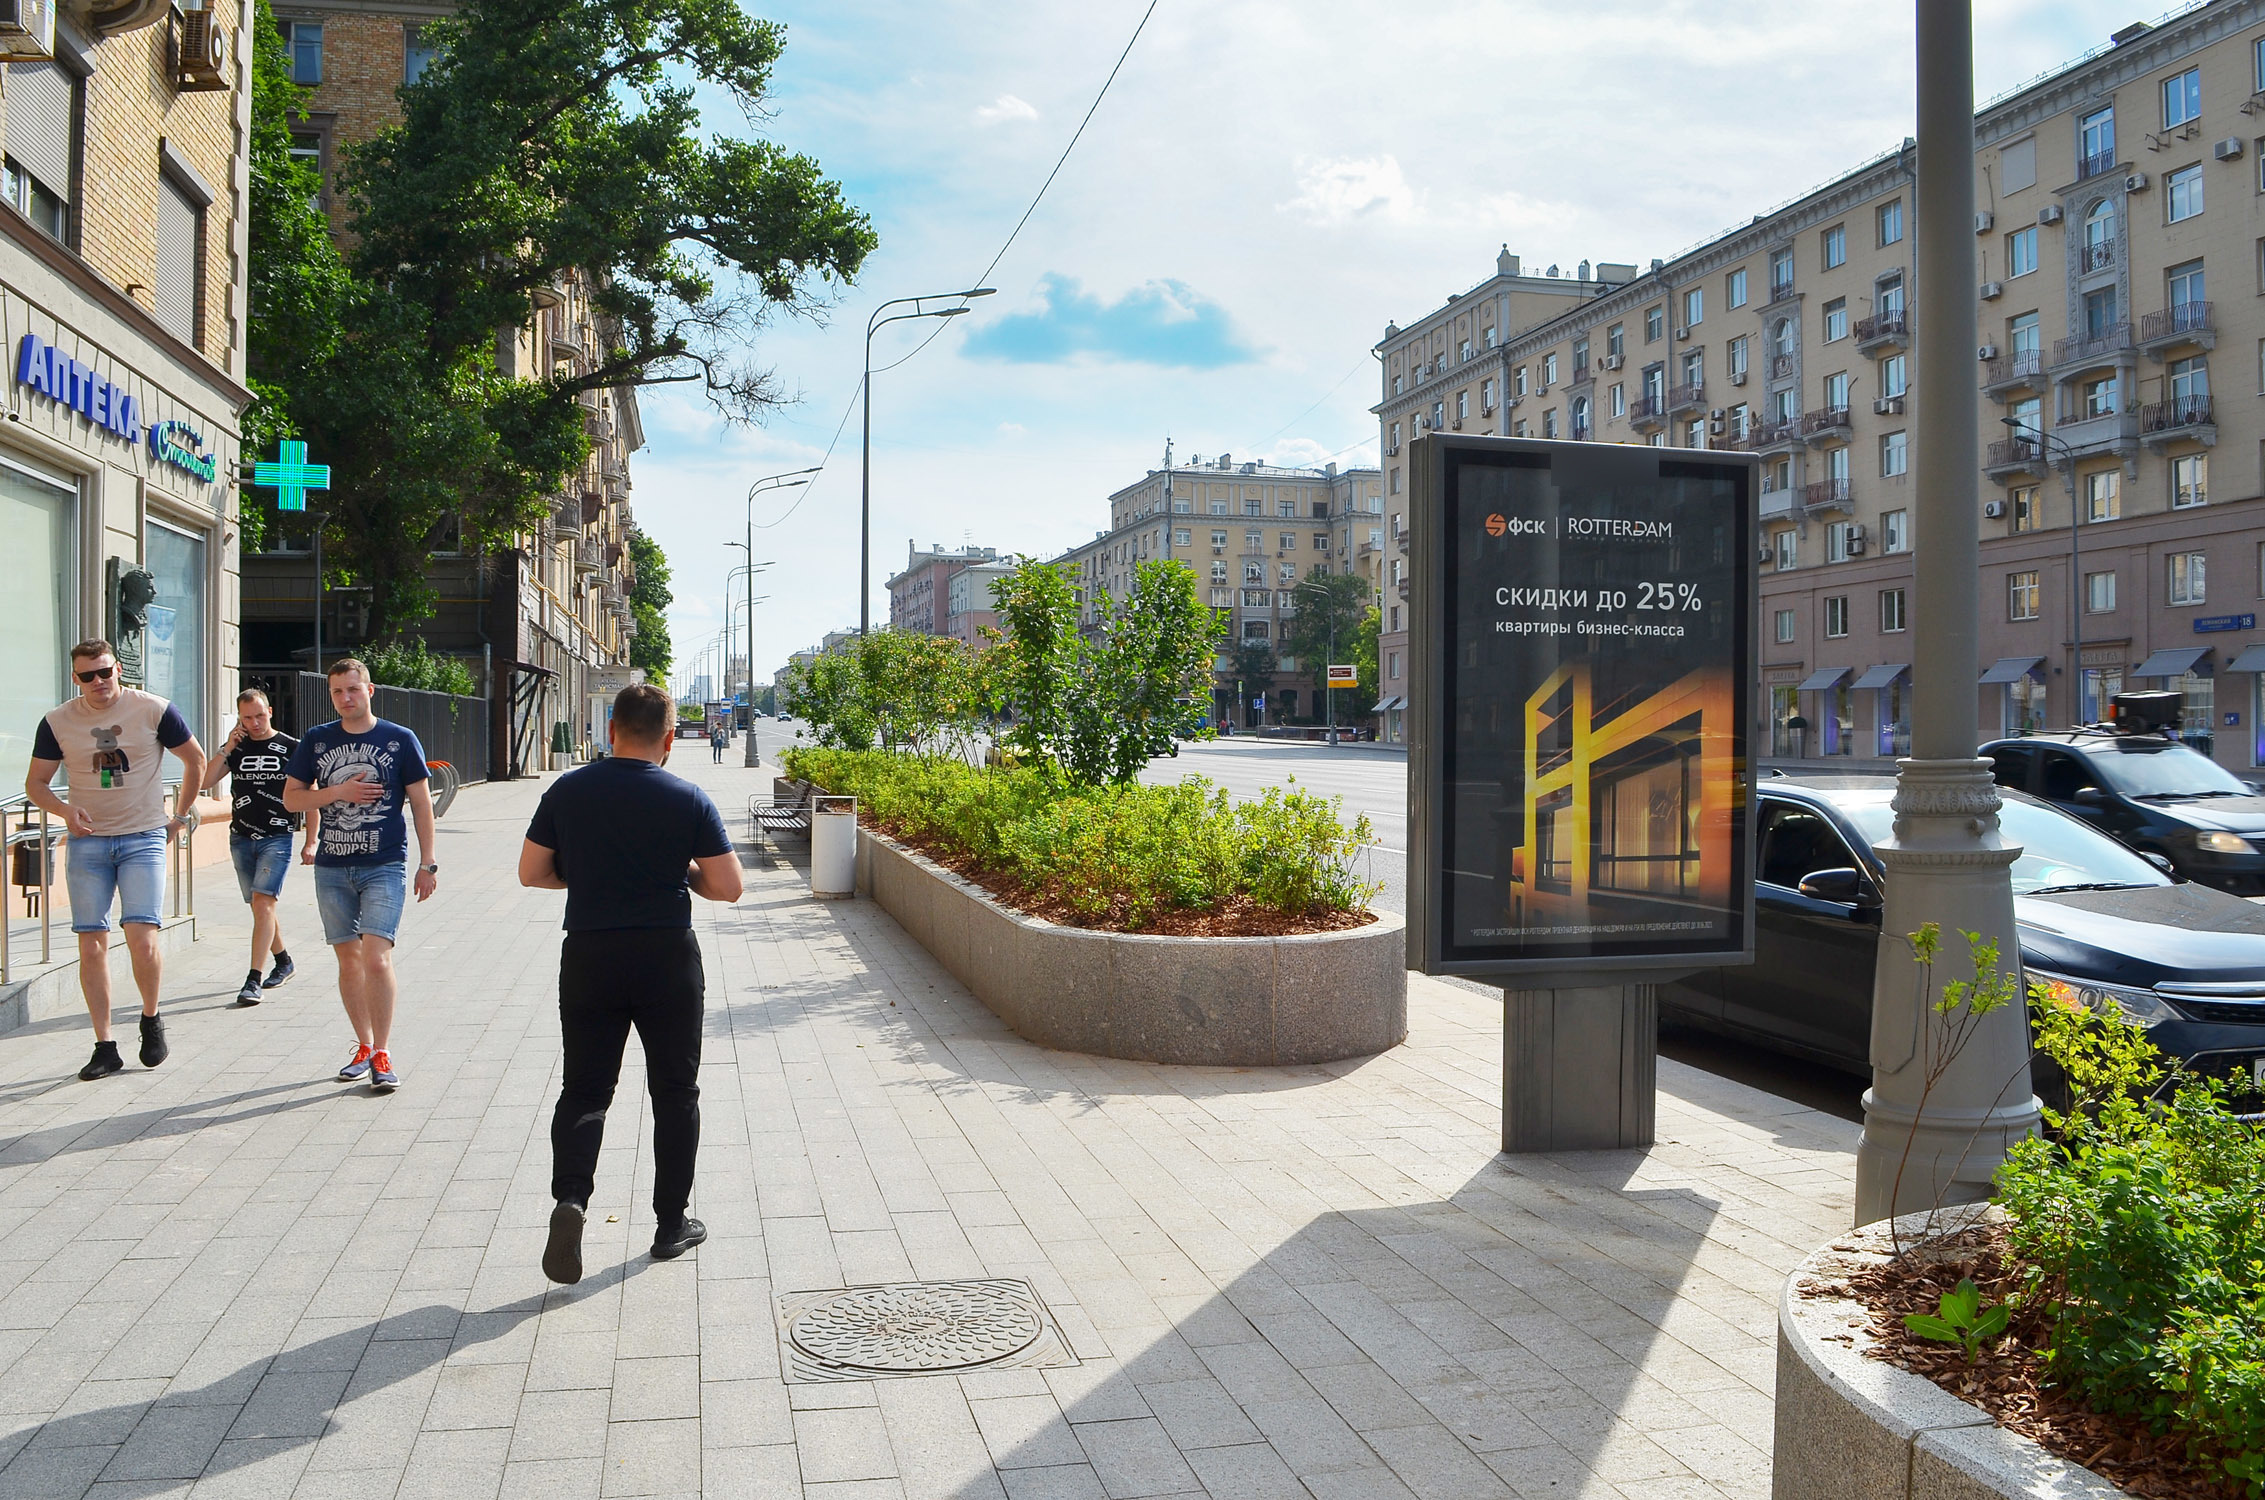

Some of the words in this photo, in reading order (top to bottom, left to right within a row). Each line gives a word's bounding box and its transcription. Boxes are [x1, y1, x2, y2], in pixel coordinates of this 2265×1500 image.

[20, 333, 141, 444] АПТЕКА
[1568, 517, 1672, 538] ROTTERDAM
[1596, 590, 1627, 612] до
[1636, 581, 1702, 612] 25%
[1495, 621, 1571, 637] квартиры
[1577, 620, 1685, 637] бизнес-класса
[2242, 616, 2251, 626] 18
[316, 742, 357, 769] NOBODY
[360, 742, 382, 758] BUT
[377, 751, 394, 768] US
[323, 840, 369, 856] TROOPS
